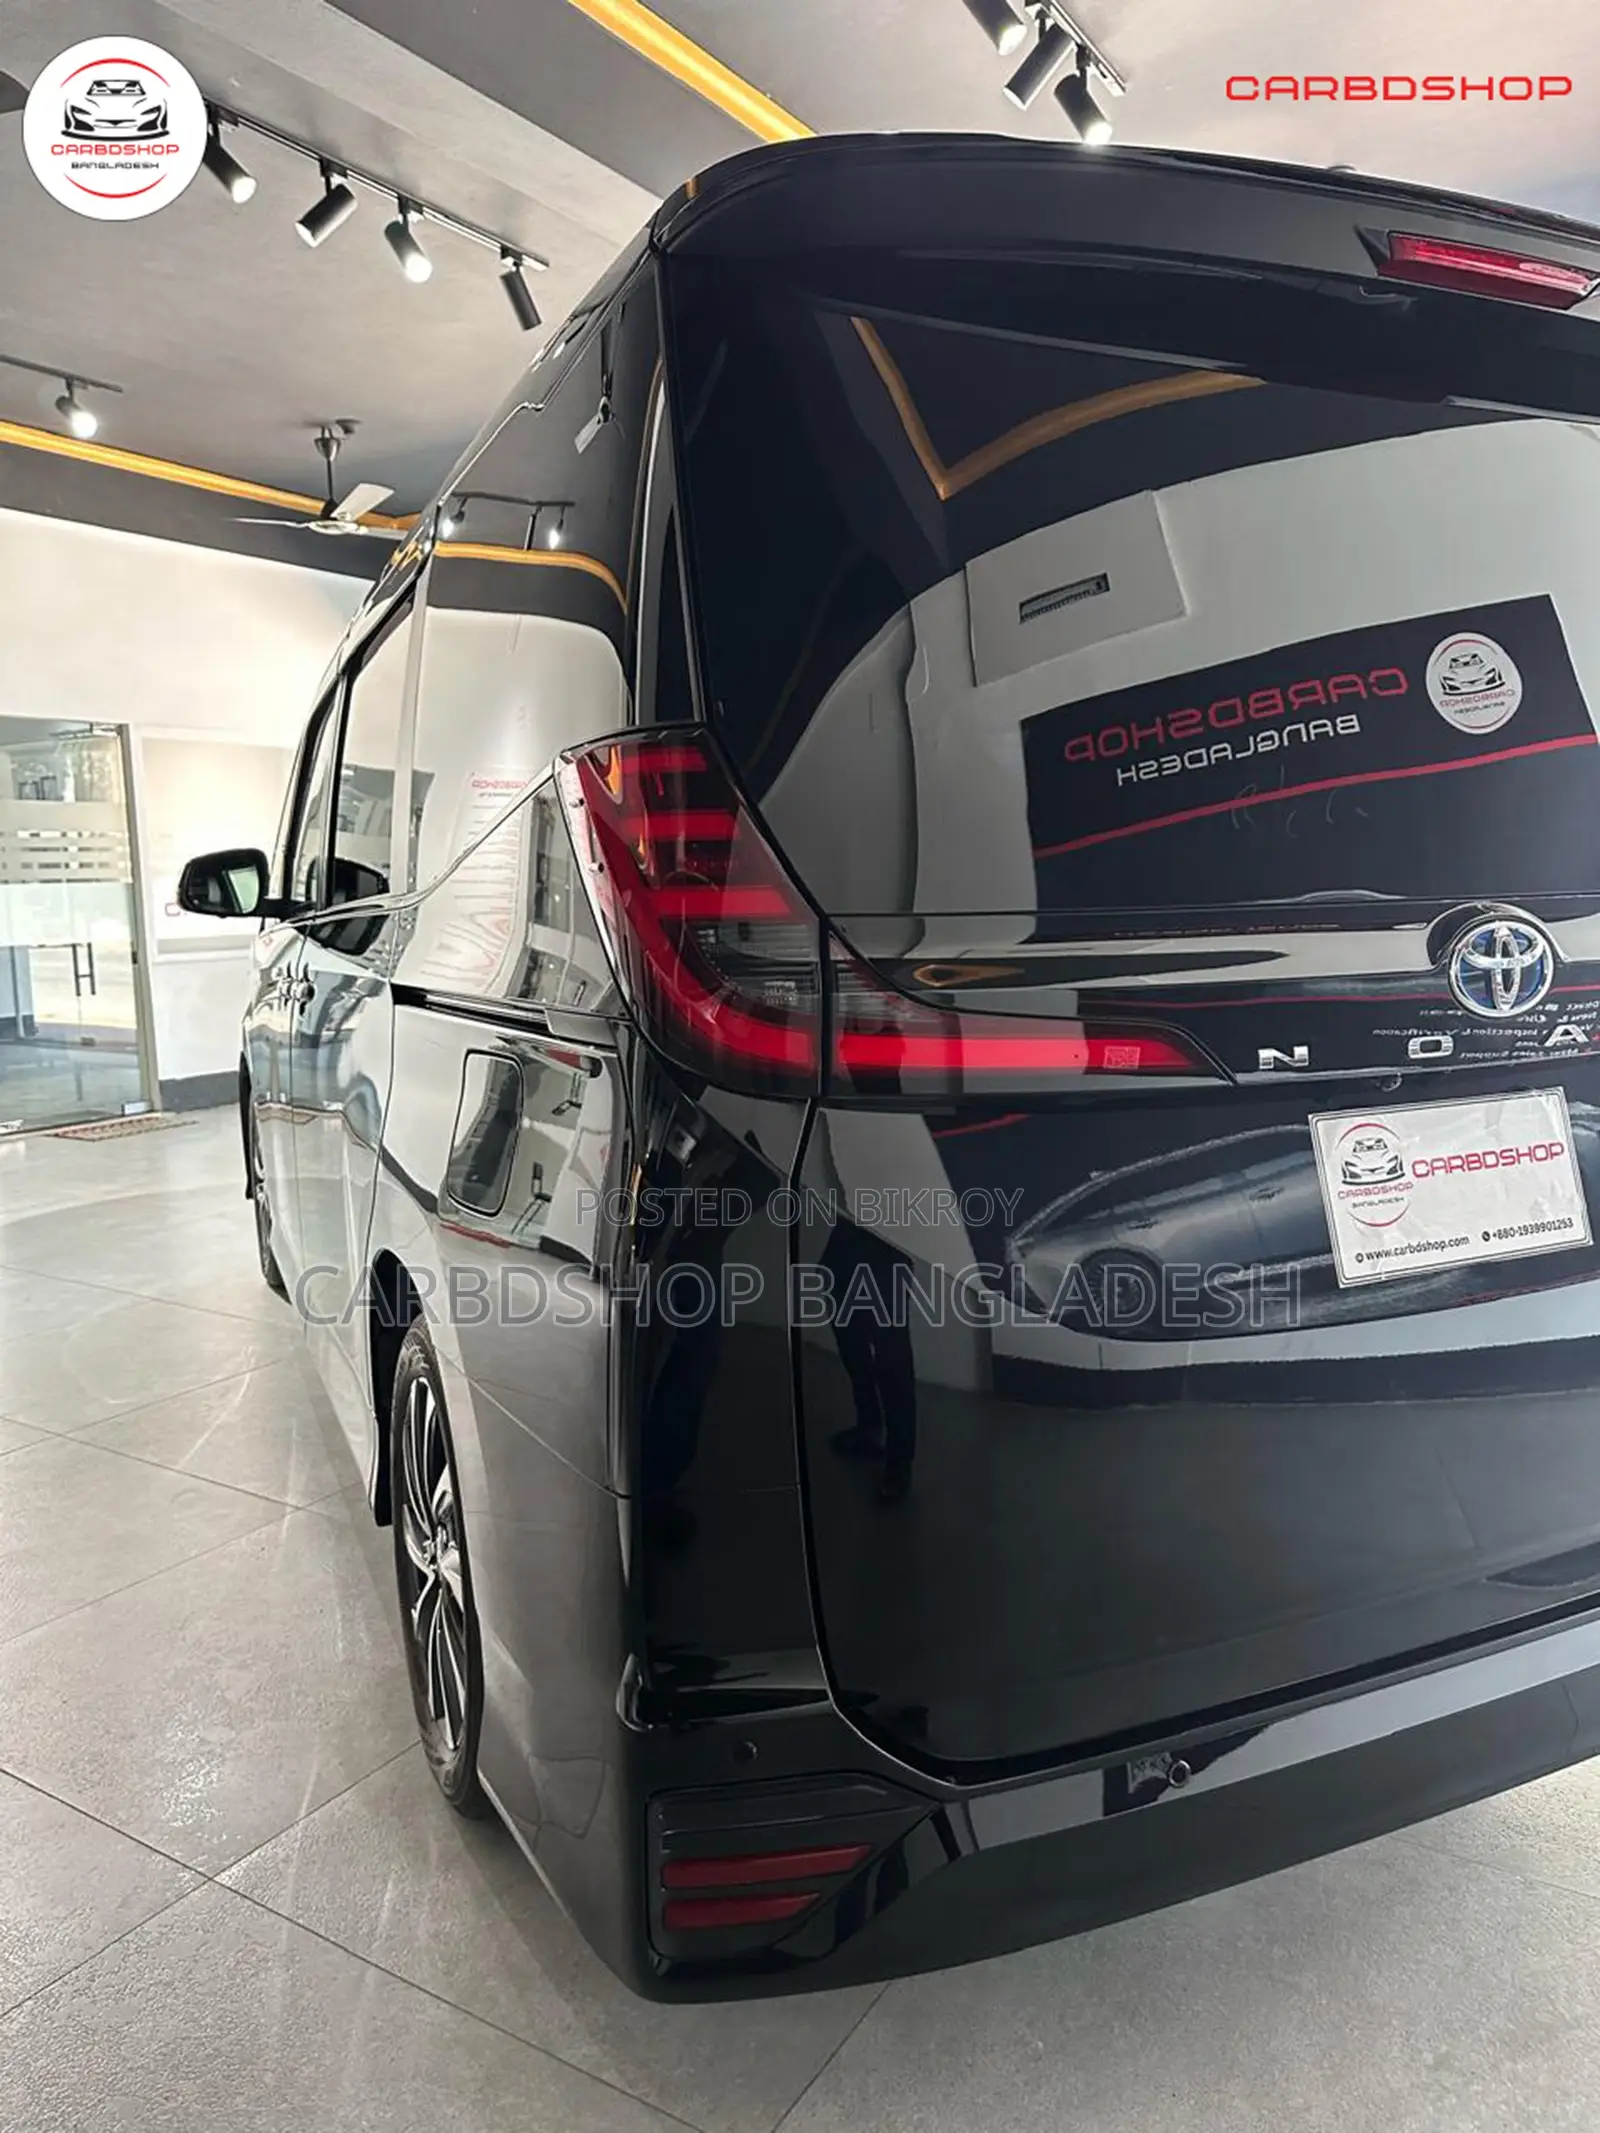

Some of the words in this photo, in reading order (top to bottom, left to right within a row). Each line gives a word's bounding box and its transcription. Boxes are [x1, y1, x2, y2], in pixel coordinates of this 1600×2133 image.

[1411, 1142, 1565, 1178] CARBDSHOP
[1337, 1181, 1414, 1200] CARBDSHOP
[1365, 1234, 1470, 1262] www.carbdshop.com
